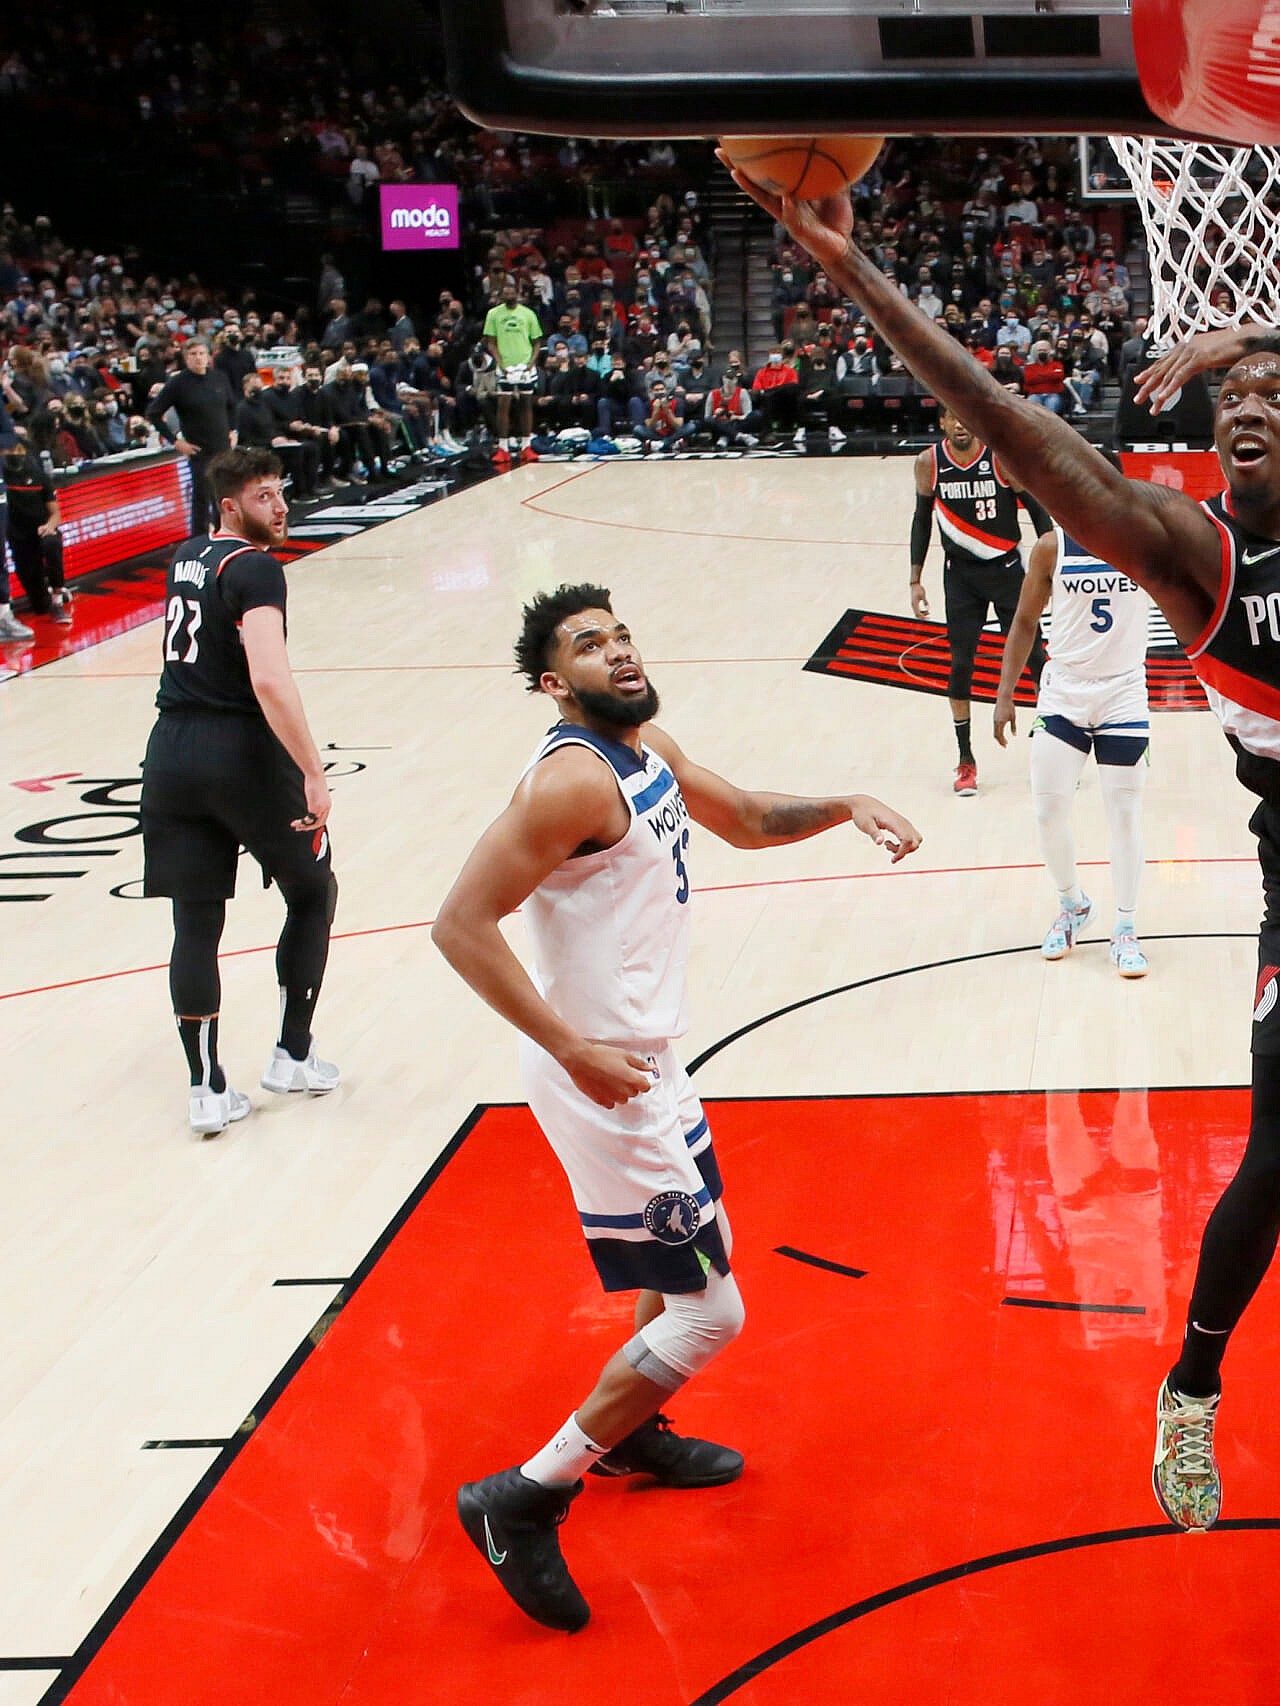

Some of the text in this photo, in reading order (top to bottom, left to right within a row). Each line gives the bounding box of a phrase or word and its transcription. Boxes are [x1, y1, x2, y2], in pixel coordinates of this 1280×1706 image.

[391, 204, 450, 228] moda
[939, 480, 996, 499] PORTLAND
[975, 500, 996, 521] 33
[1062, 578, 1138, 594] WOLVES
[1090, 599, 1113, 633] 5
